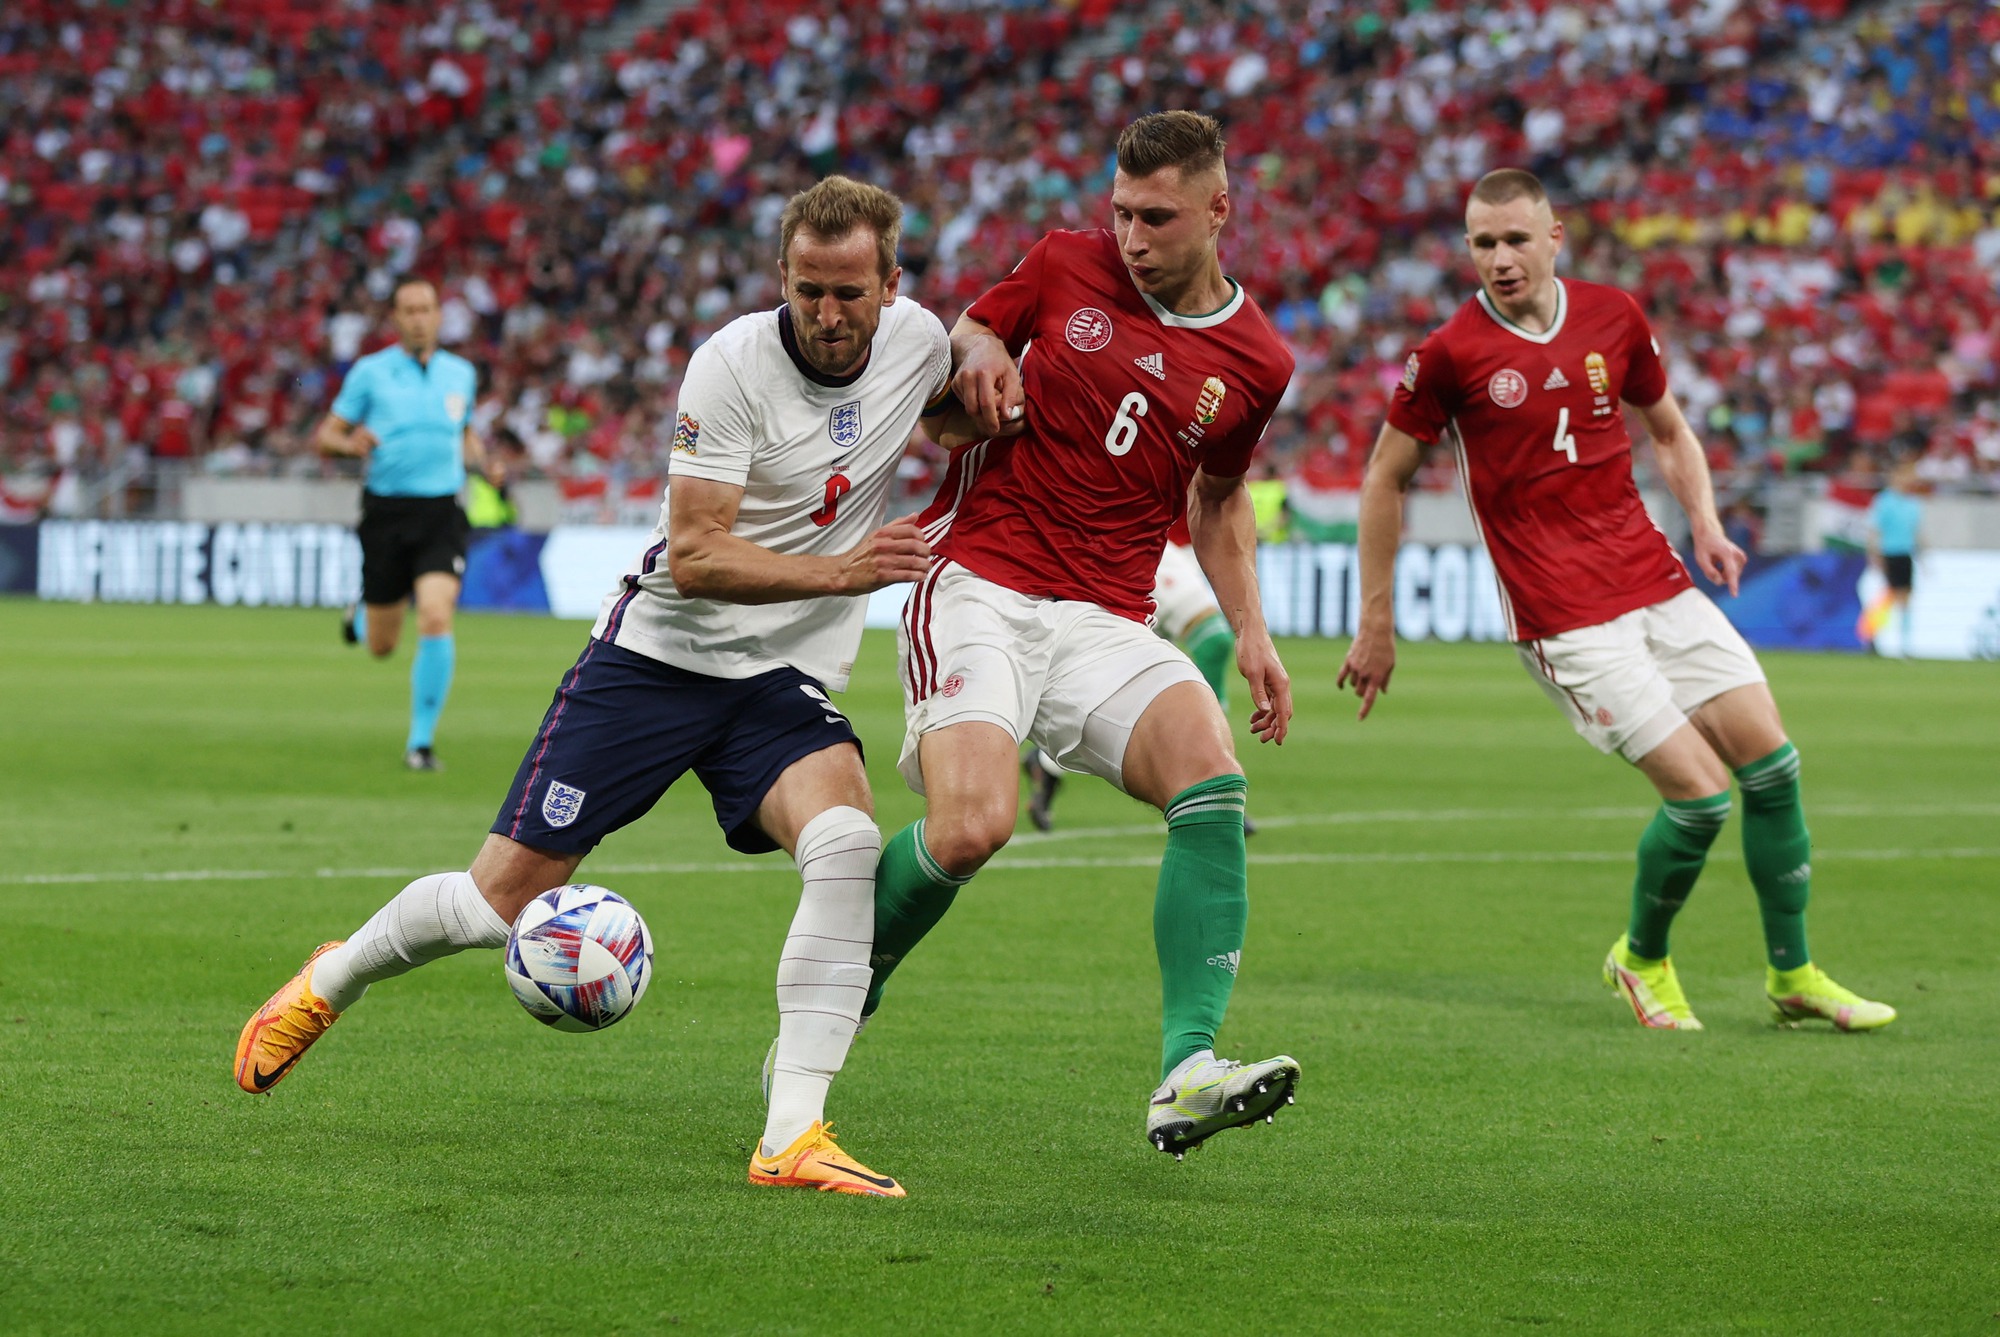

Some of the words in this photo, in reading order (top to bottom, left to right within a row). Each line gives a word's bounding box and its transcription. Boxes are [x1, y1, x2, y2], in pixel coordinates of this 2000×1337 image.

[1134, 358, 1166, 380] adidas
[1105, 391, 1149, 456] 6
[1553, 407, 1578, 464] 4
